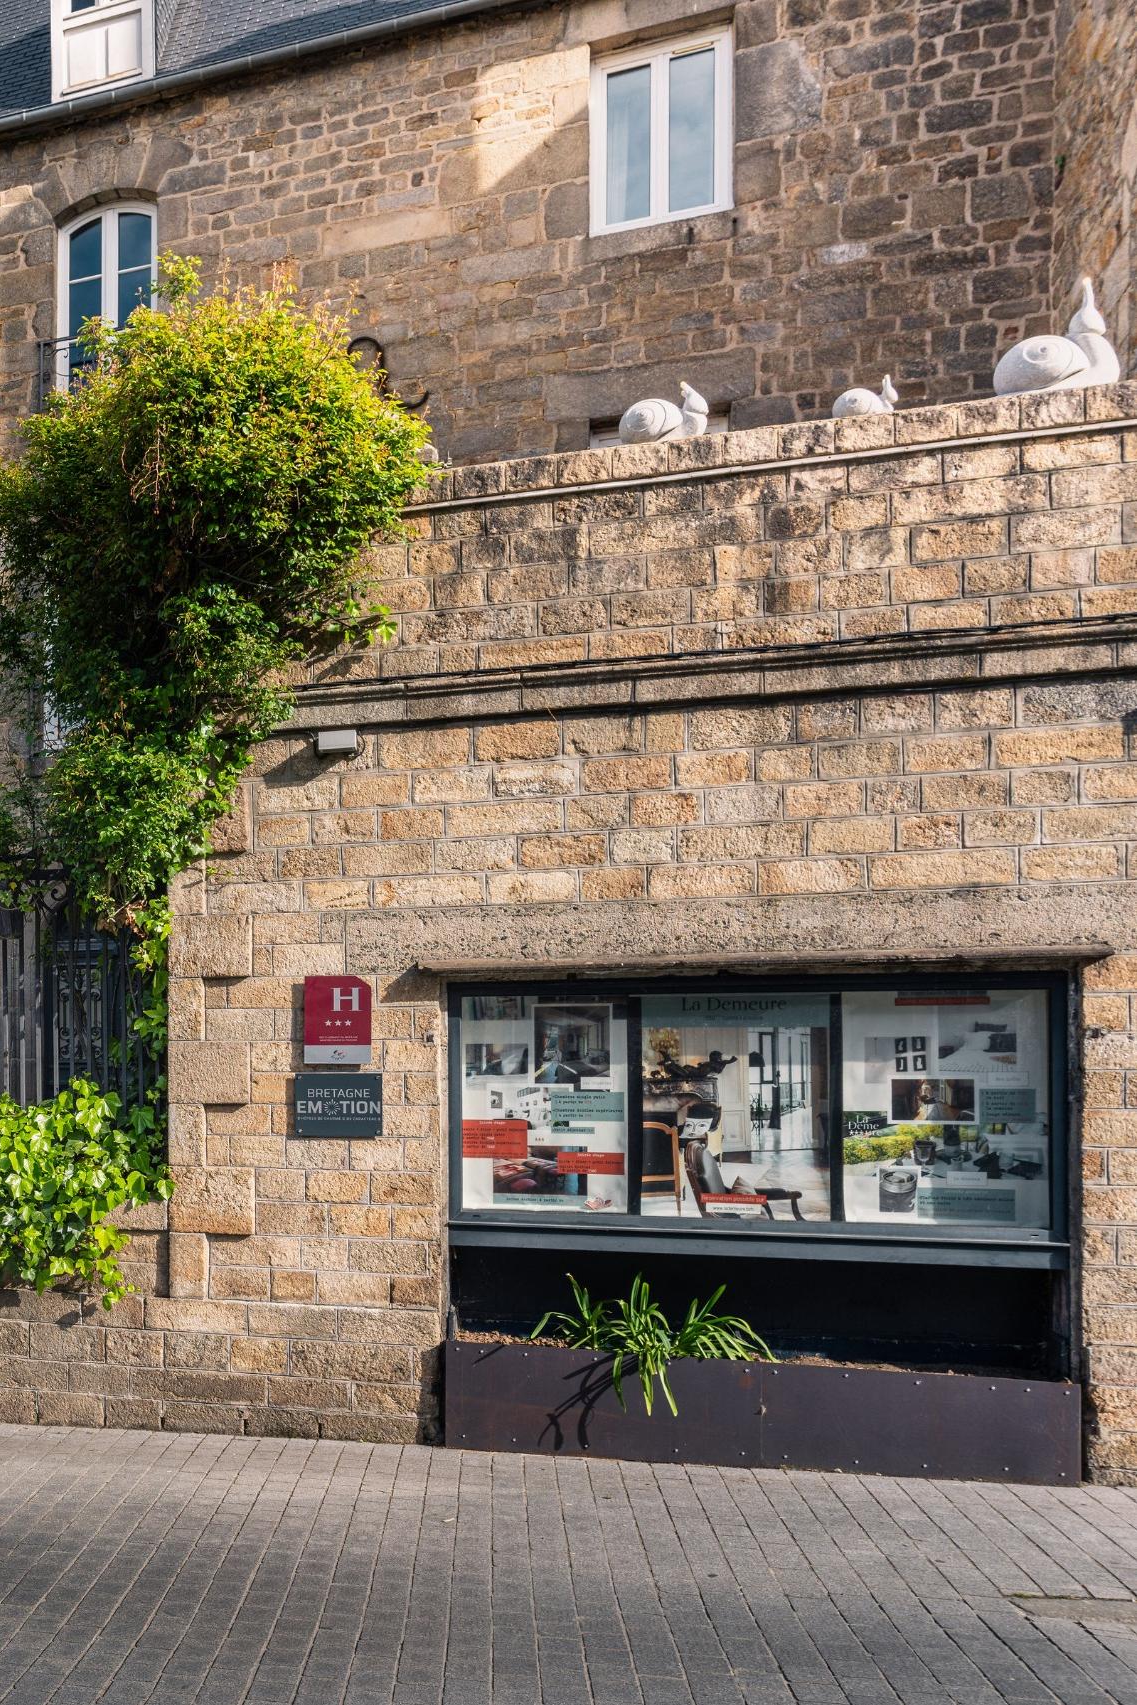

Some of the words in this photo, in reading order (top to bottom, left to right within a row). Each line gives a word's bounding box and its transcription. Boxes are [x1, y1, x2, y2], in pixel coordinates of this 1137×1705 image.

[331, 987, 363, 1012] H
[682, 997, 701, 1011] La
[707, 996, 787, 1011] Demeure
[307, 1088, 370, 1098] BRETAGNE
